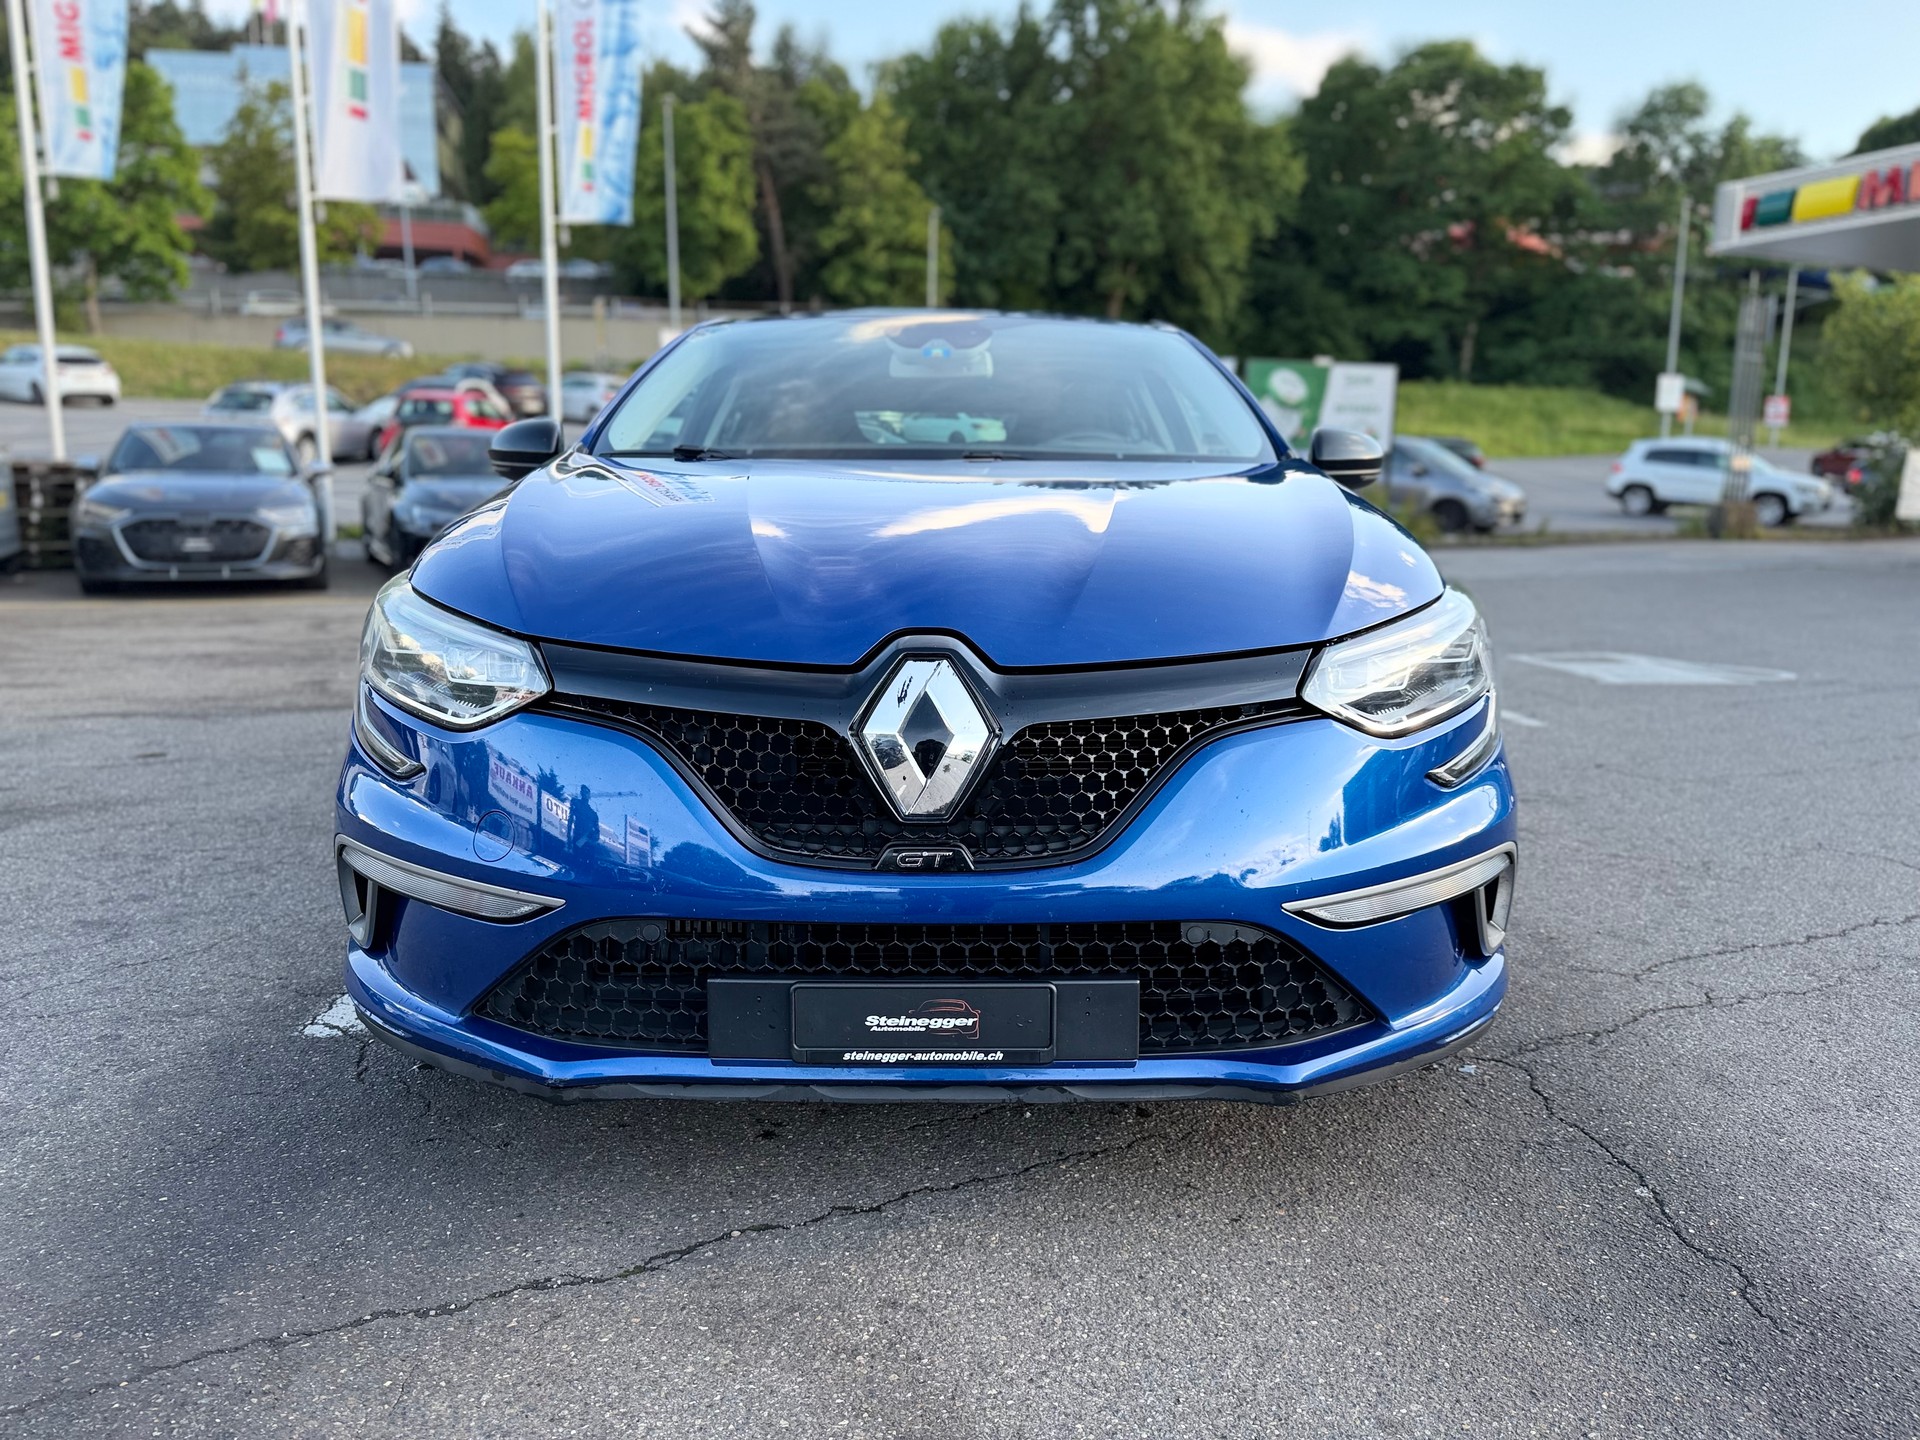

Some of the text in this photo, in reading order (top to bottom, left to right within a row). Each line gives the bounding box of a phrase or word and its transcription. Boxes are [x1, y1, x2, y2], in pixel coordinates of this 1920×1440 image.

[573, 19, 594, 120] MIGROL
[896, 851, 954, 868] GT
[865, 1015, 978, 1028] Steinegger
[842, 1050, 1004, 1063] steinegger-automobile.ch
